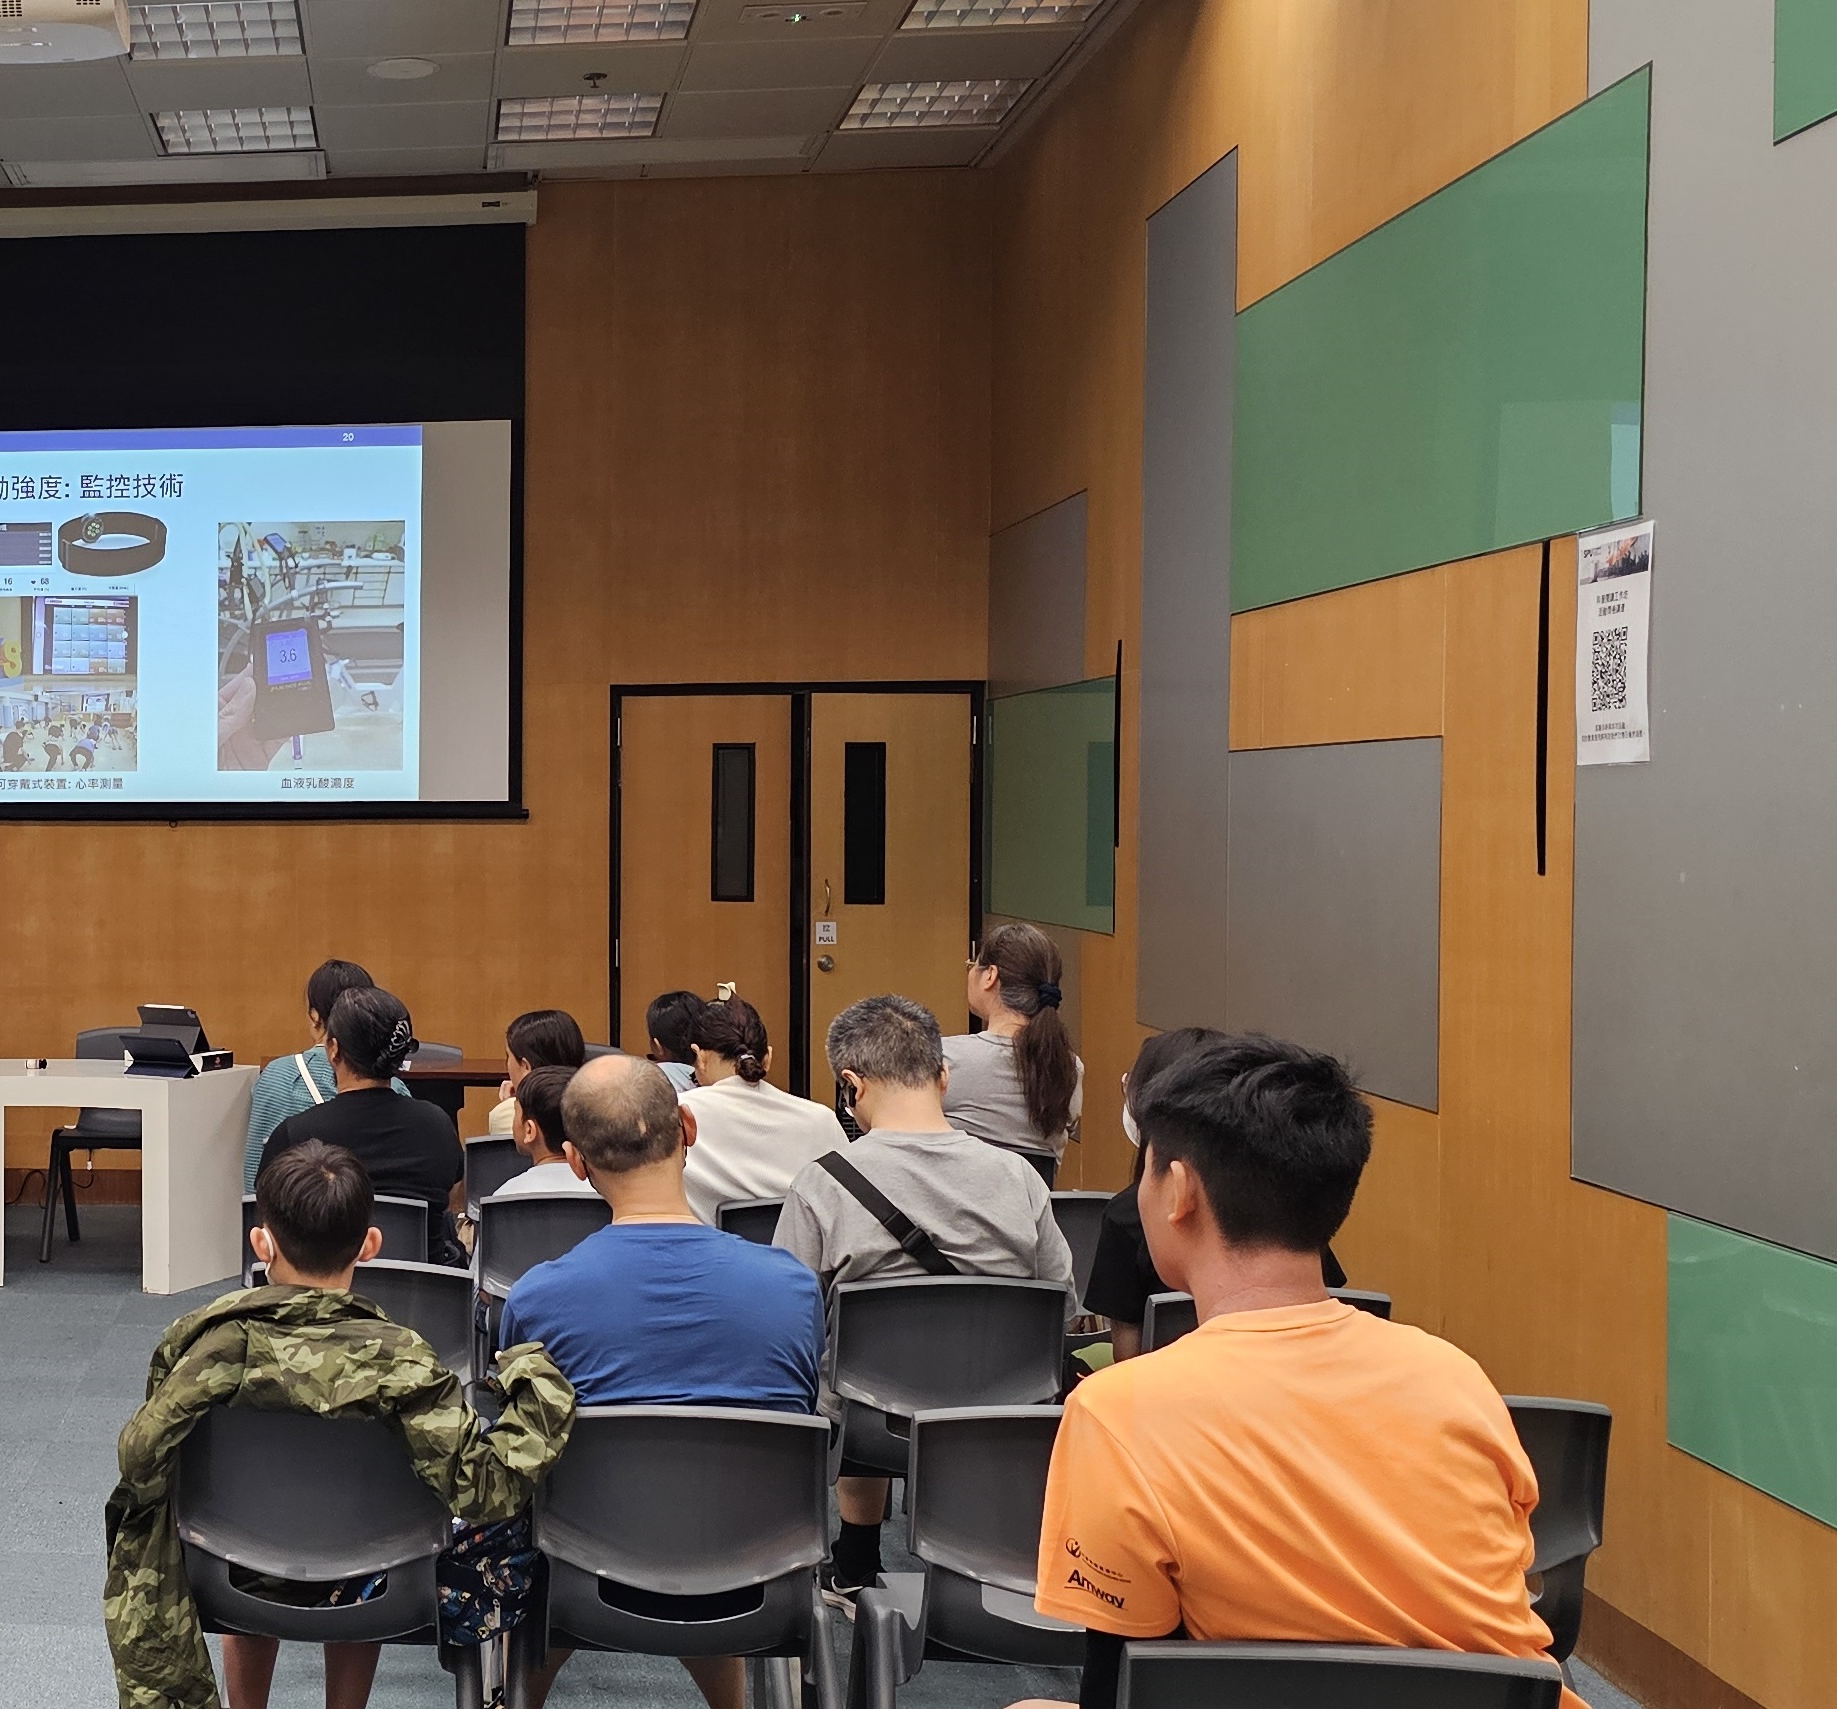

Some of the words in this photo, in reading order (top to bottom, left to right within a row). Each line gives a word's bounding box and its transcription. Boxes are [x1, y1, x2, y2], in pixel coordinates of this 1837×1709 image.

[343, 433, 354, 441] 20
[79, 473, 184, 499] 監控技術
[279, 648, 297, 663] 3.6
[75, 777, 124, 790] 心率測量
[281, 777, 355, 789] 血液乳酸濃度
[1067, 1569, 1126, 1609] Amway
